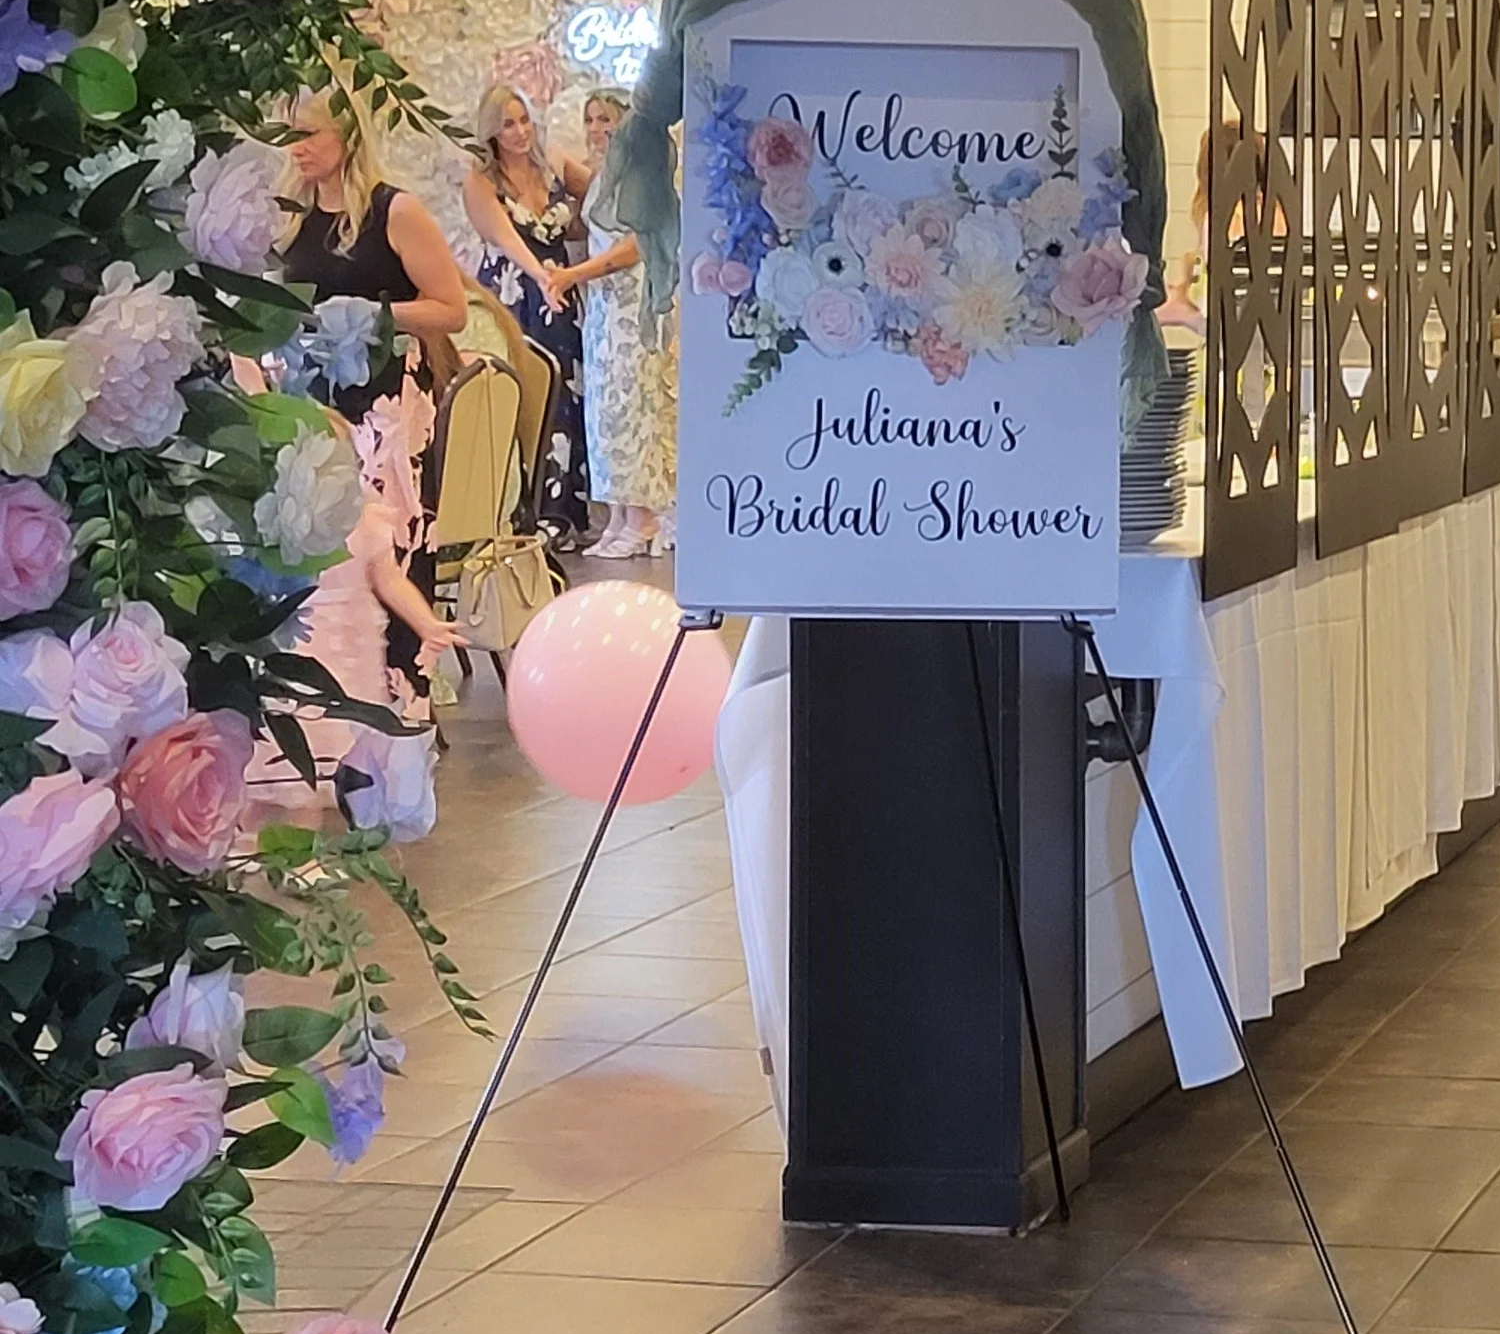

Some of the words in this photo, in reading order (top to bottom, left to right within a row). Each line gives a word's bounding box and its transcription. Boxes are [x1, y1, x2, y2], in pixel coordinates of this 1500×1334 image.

[768, 89, 1048, 165] Welcome
[786, 387, 1026, 470] Juliana's
[705, 474, 891, 537] Bridal
[903, 479, 1104, 541] Shower
